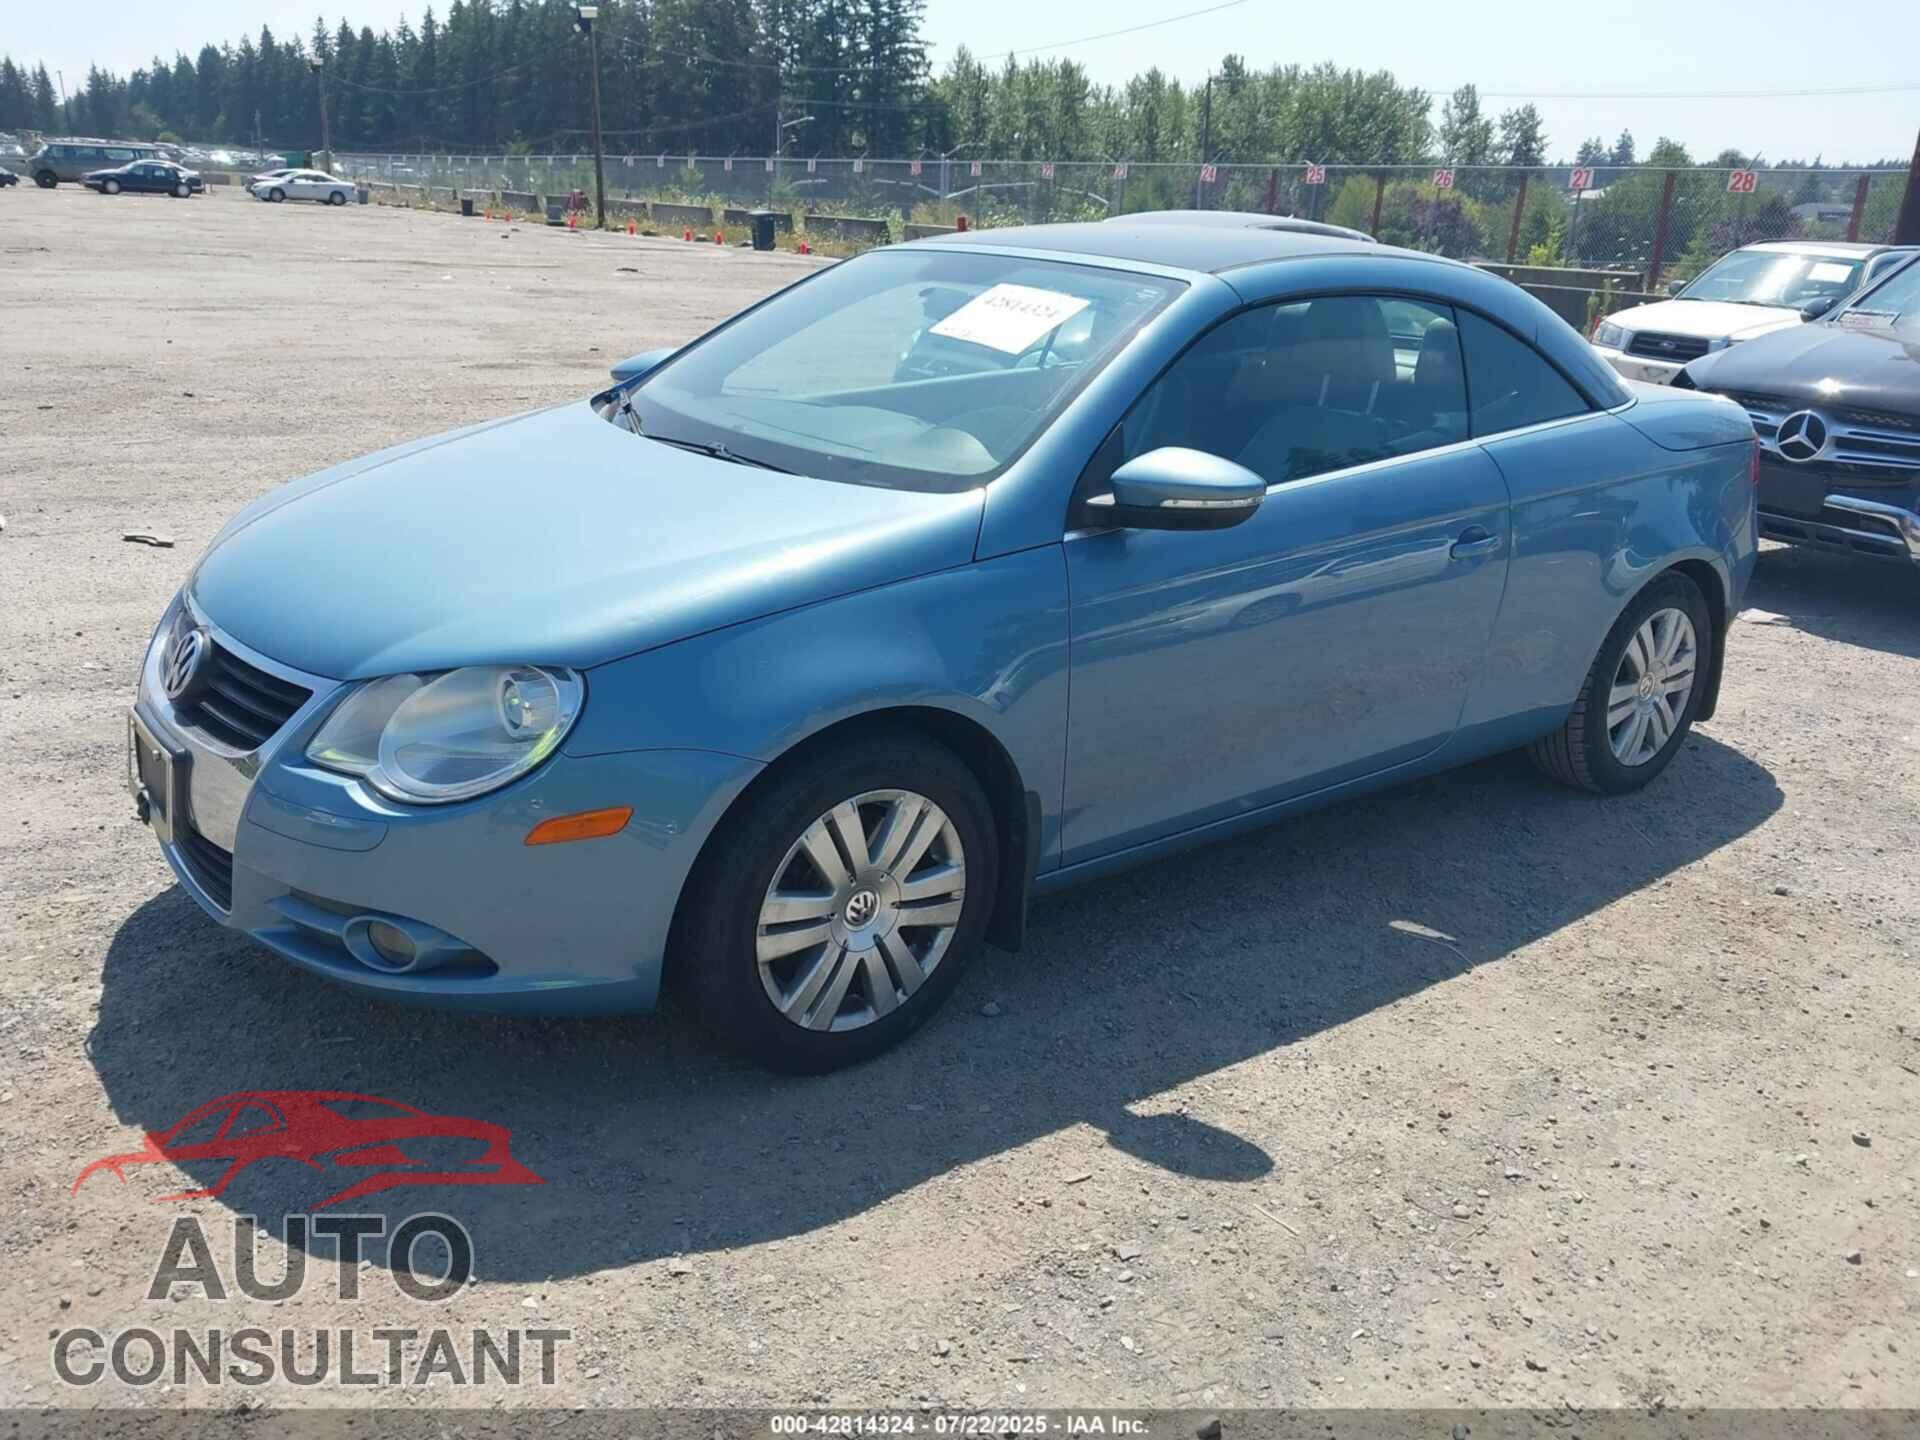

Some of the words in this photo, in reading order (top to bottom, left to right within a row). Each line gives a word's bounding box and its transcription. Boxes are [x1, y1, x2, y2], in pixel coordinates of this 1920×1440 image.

[1308, 167, 1323, 182] 25
[1435, 170, 1452, 187] 26
[1573, 170, 1590, 187] 27
[1730, 173, 1755, 192] 28
